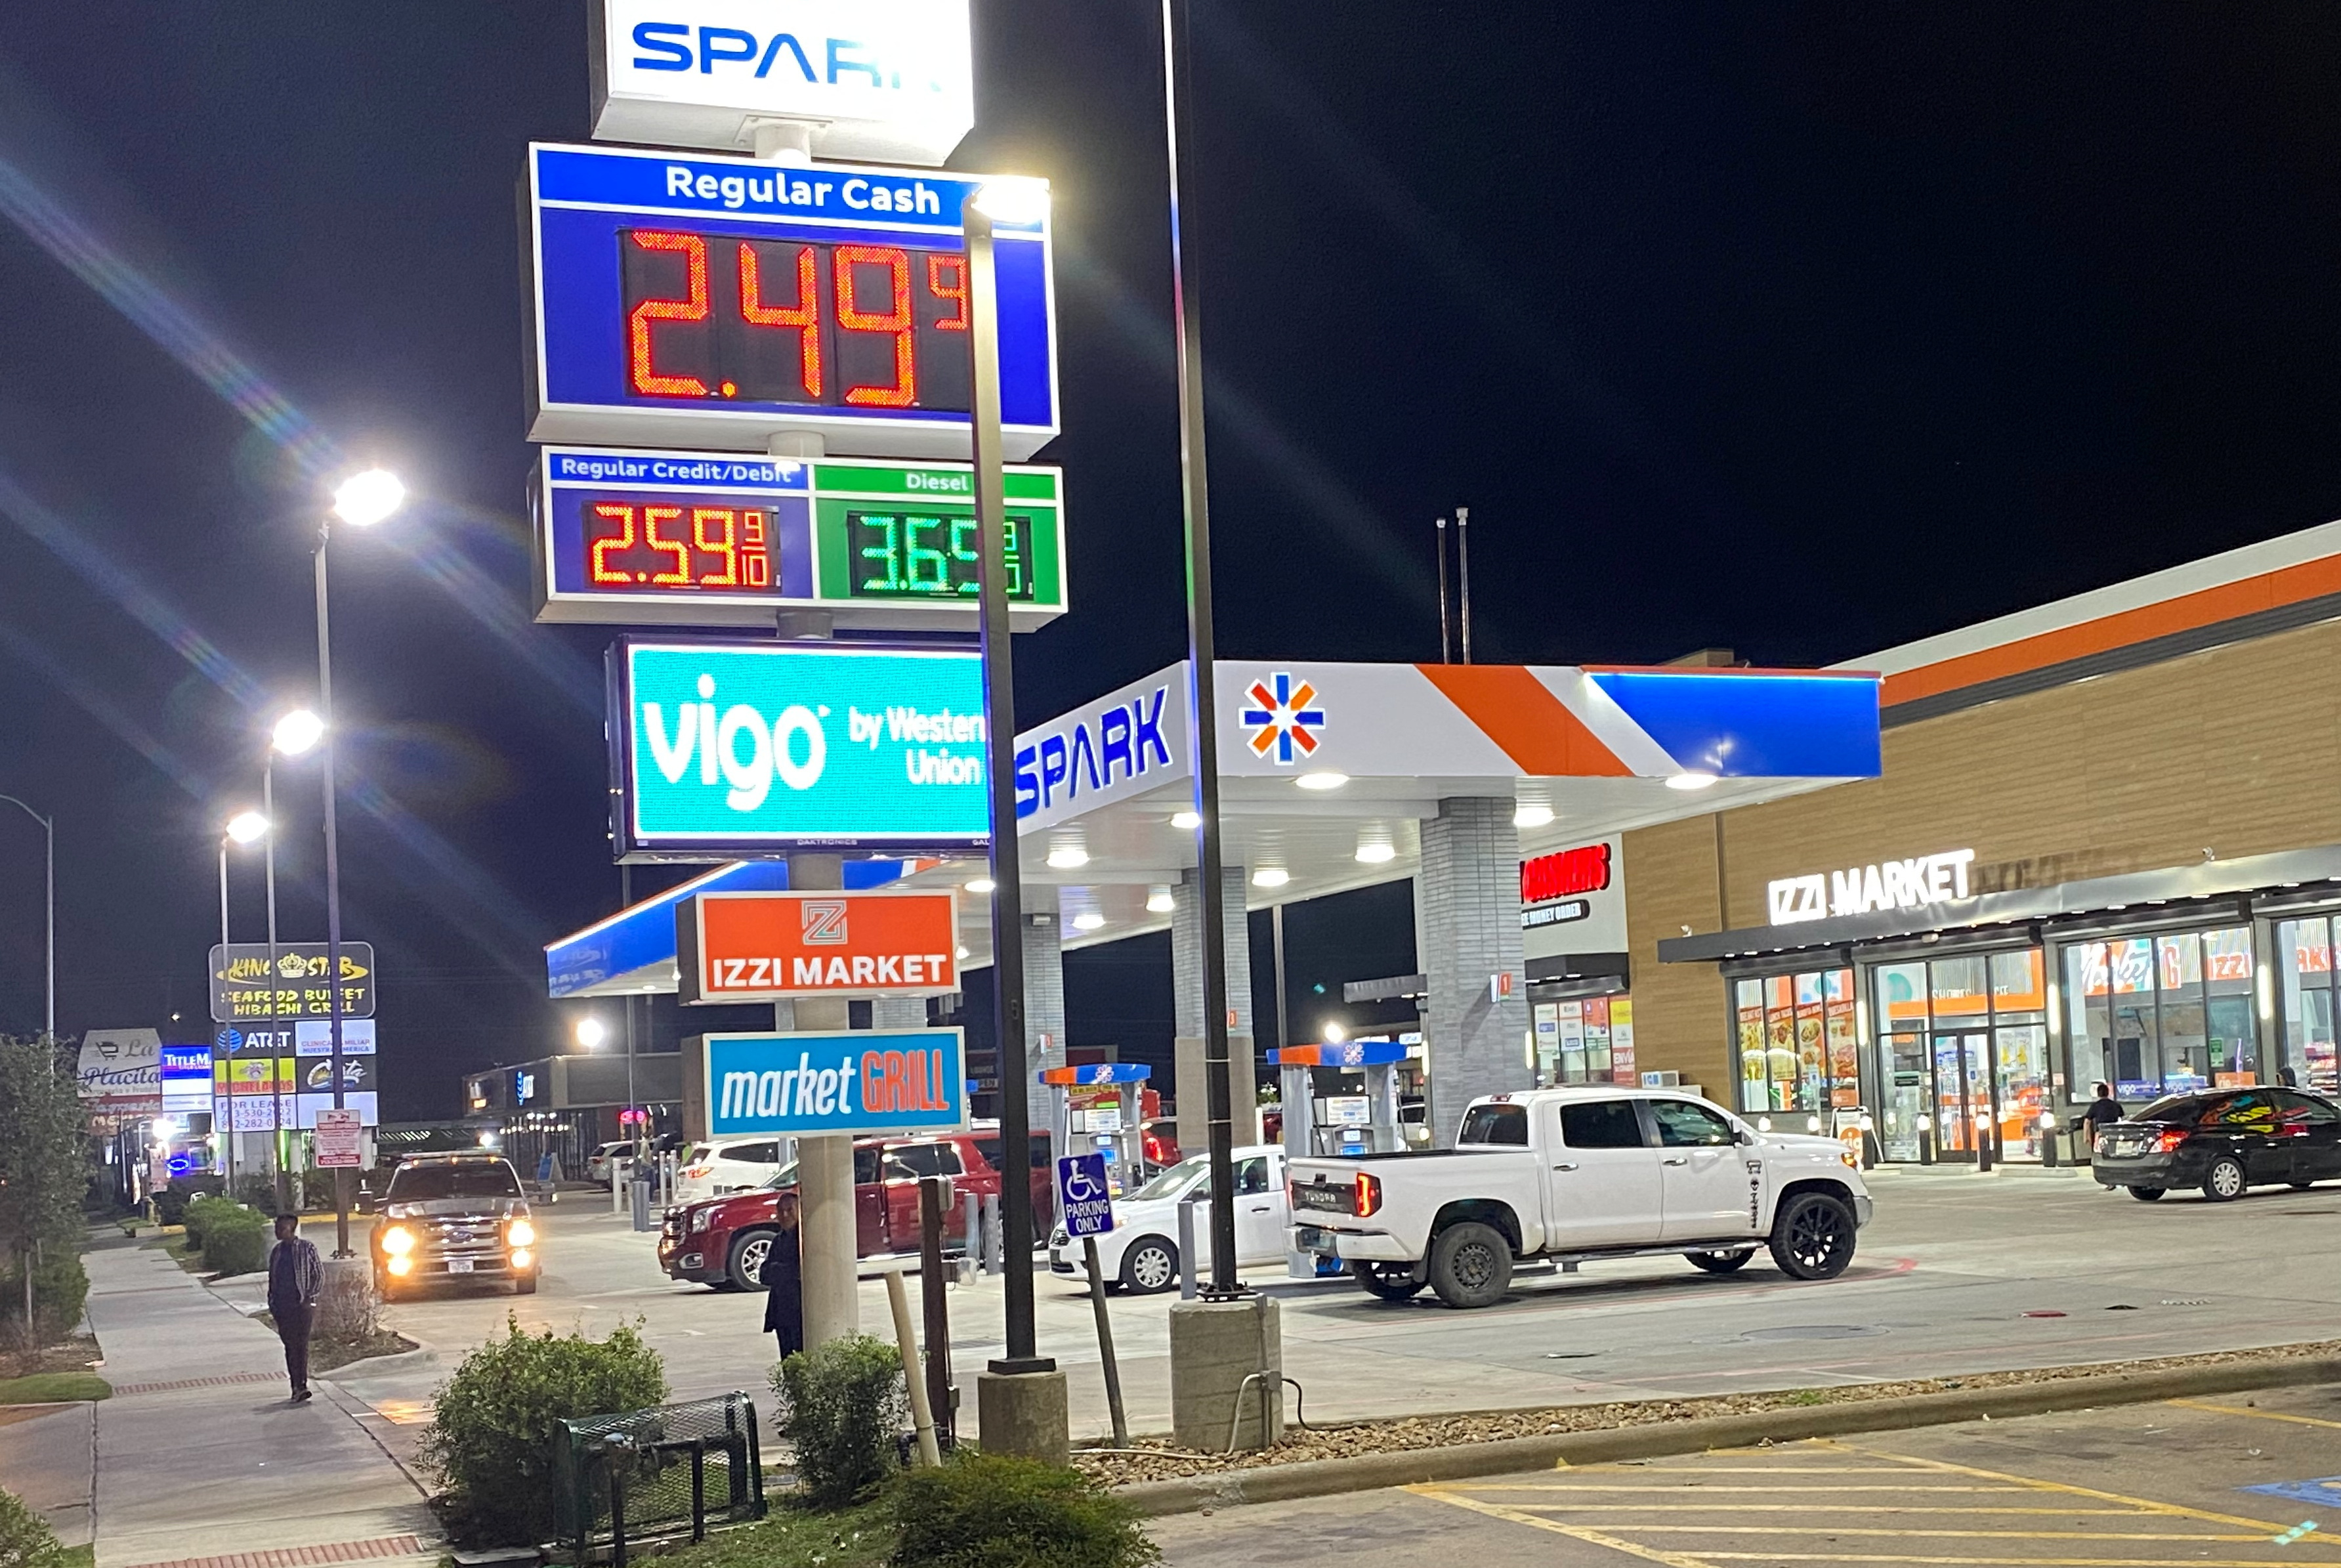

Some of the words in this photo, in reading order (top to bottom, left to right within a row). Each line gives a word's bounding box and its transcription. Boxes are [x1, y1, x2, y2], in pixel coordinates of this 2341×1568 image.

[632, 22, 942, 92] SPAR
[666, 166, 832, 208] Regular
[843, 179, 940, 214] Cash
[631, 230, 916, 406] 2.49
[562, 458, 648, 478] Regular
[652, 462, 791, 482] Credit/Debit
[906, 473, 969, 491] Diesel
[593, 505, 737, 585] 2.59
[643, 673, 826, 811] vigo
[849, 706, 883, 750] by
[1014, 685, 1173, 820] SPARK
[906, 746, 981, 785] Union
[1768, 874, 1827, 926] IZZI
[1829, 848, 1975, 917] MARKET
[308, 956, 352, 977] STR
[713, 958, 781, 987] IZZI
[793, 954, 947, 985] MARKET
[305, 988, 366, 1000] BUET
[308, 1002, 355, 1014] GRL
[125, 1039, 155, 1057] La
[245, 1032, 291, 1048] AT&T
[164, 1053, 211, 1067] TITLEM
[720, 1052, 856, 1118] market
[861, 1049, 950, 1113] GRILL
[222, 1107, 291, 1118] 73-530-222
[222, 1117, 291, 1129] 82-282-024
[1066, 1199, 1108, 1219] PARKING
[1076, 1216, 1103, 1233] ONLY
